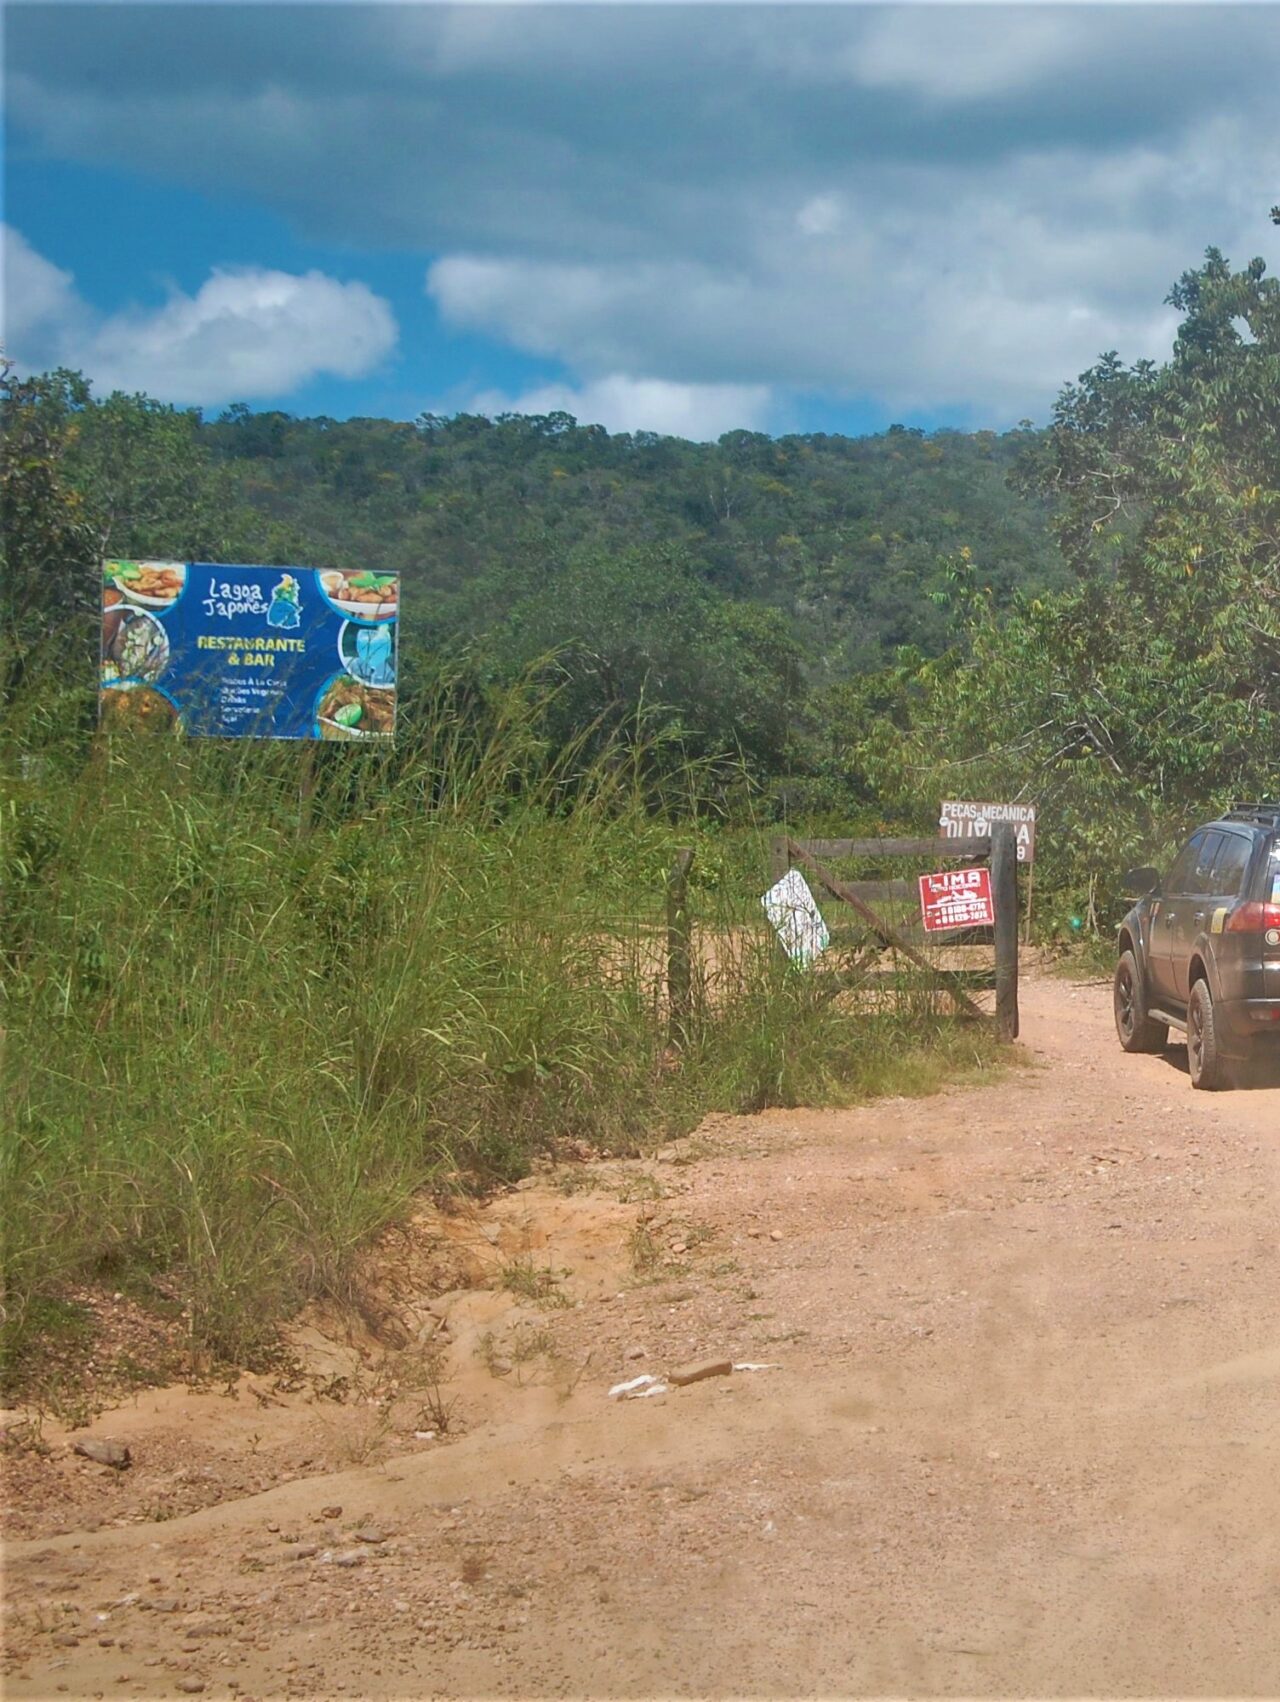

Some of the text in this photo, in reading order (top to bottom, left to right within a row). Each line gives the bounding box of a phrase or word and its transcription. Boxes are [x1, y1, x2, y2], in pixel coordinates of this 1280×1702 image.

[209, 578, 263, 601] Lagoa
[202, 599, 269, 620] Japonês
[197, 636, 306, 653] RESTAURANTE
[228, 653, 275, 667] & BAR
[928, 871, 981, 889] LIMA
